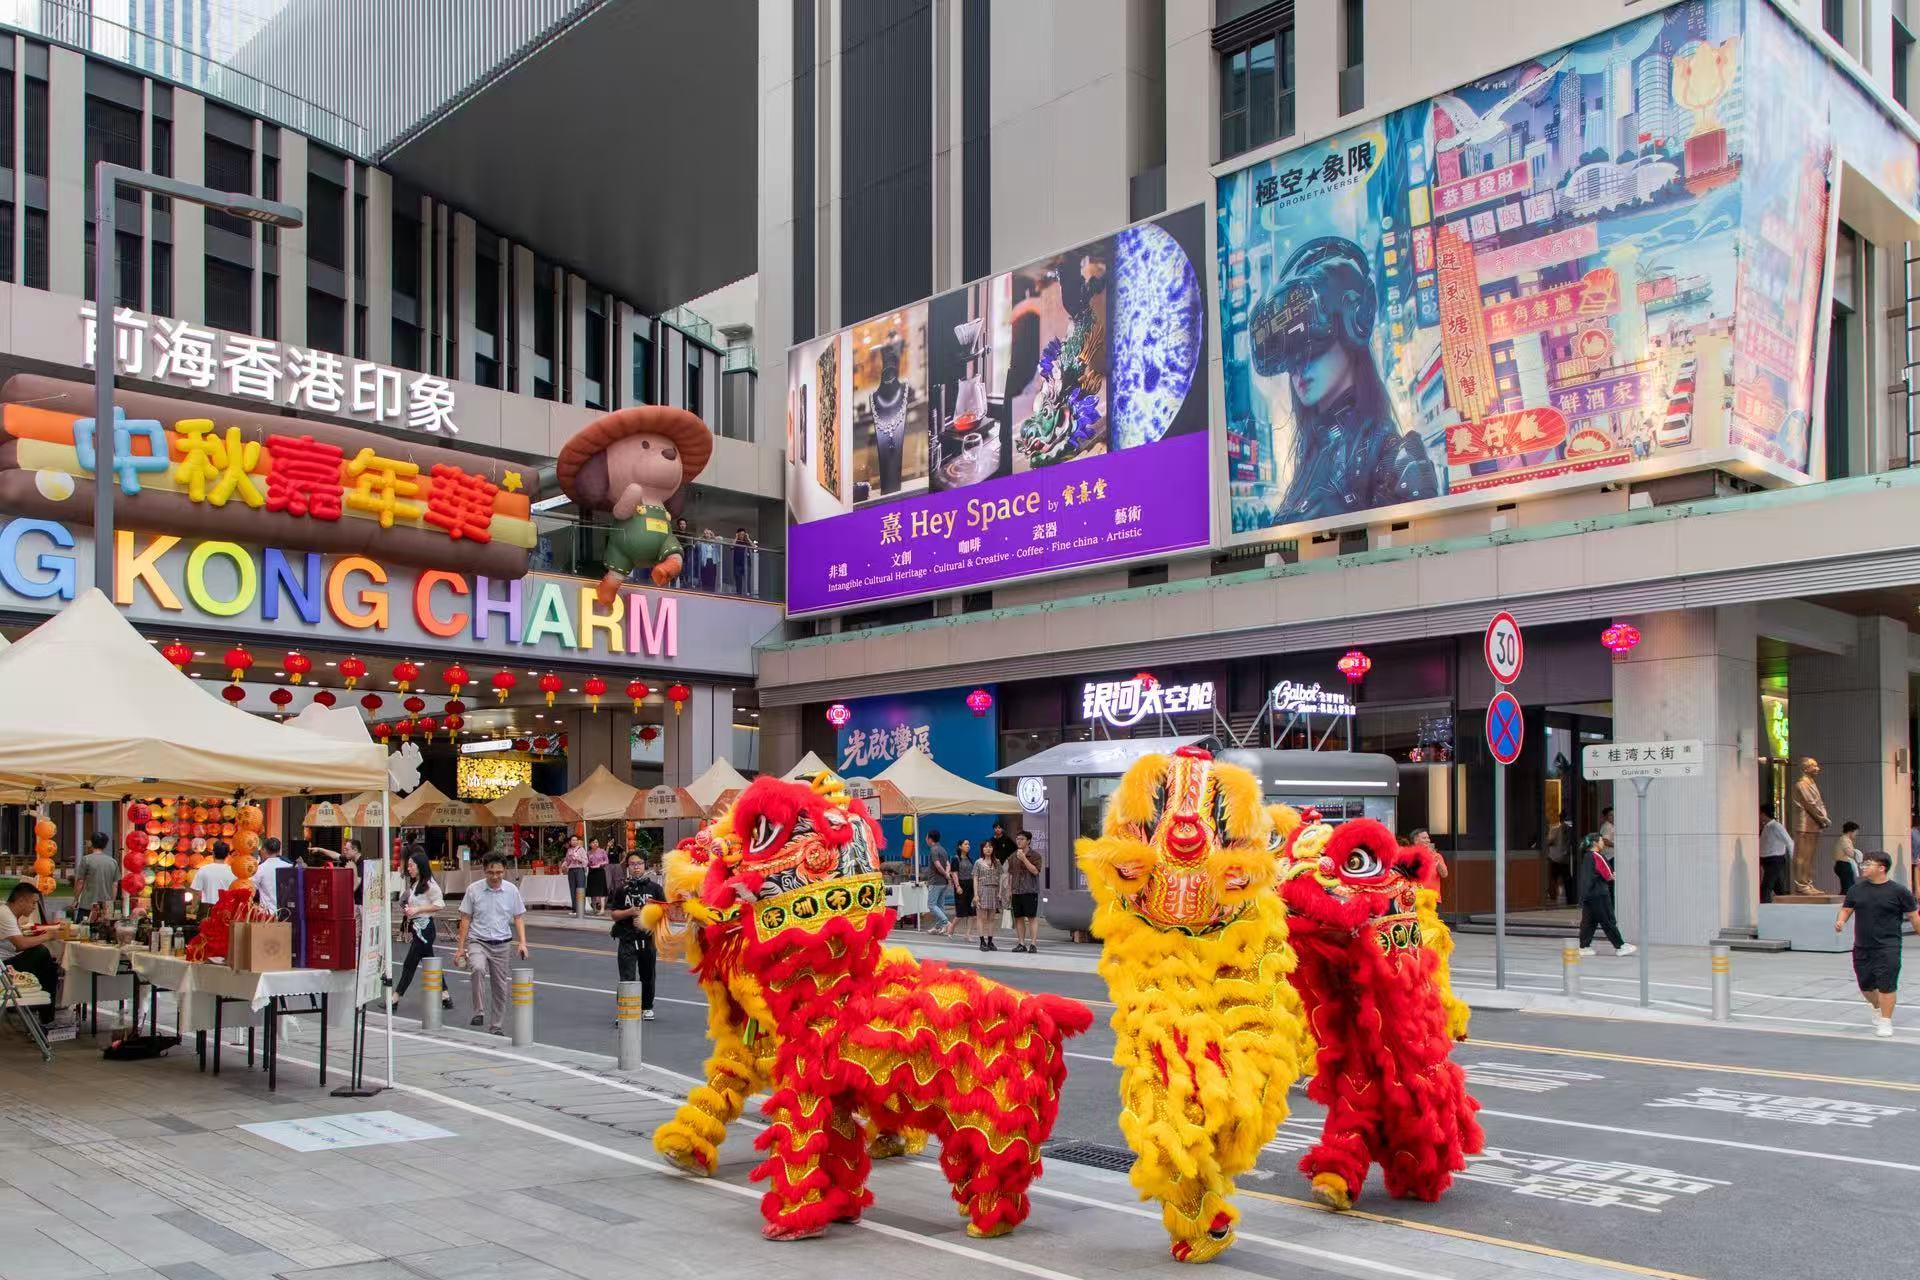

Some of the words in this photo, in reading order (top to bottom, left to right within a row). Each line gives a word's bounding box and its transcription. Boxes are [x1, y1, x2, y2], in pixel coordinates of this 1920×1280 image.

[1443, 169, 1513, 208] 恭喜發財
[1438, 248, 1478, 397] 避風塘炒蟹
[78, 305, 460, 434] 前海香港印象
[73, 405, 499, 544] 中秋嘉年華
[911, 509, 957, 539] Hey
[966, 491, 1041, 531] Space
[1048, 499, 1059, 511] by
[958, 537, 981, 555] 咖啡
[1032, 521, 1057, 541] 瓷器
[1114, 505, 1142, 526] 藝術
[828, 579, 863, 592] Intangible
[864, 572, 893, 585] Cultural
[895, 568, 928, 581] Heritage
[933, 559, 965, 574] Cultural
[967, 558, 974, 568] &
[975, 551, 1010, 567] Creative
[1016, 545, 1044, 558] Coffee
[1052, 540, 1071, 552] Fine
[1073, 535, 1098, 548] china
[1106, 527, 1143, 542] Artistic
[113, 530, 390, 631] KONG
[413, 568, 678, 657] CHARM
[1495, 631, 1516, 667] 30
[1082, 679, 1215, 726] 银河太空舱
[1592, 750, 1600, 758] 北
[1607, 746, 1674, 762] 桂湾大街
